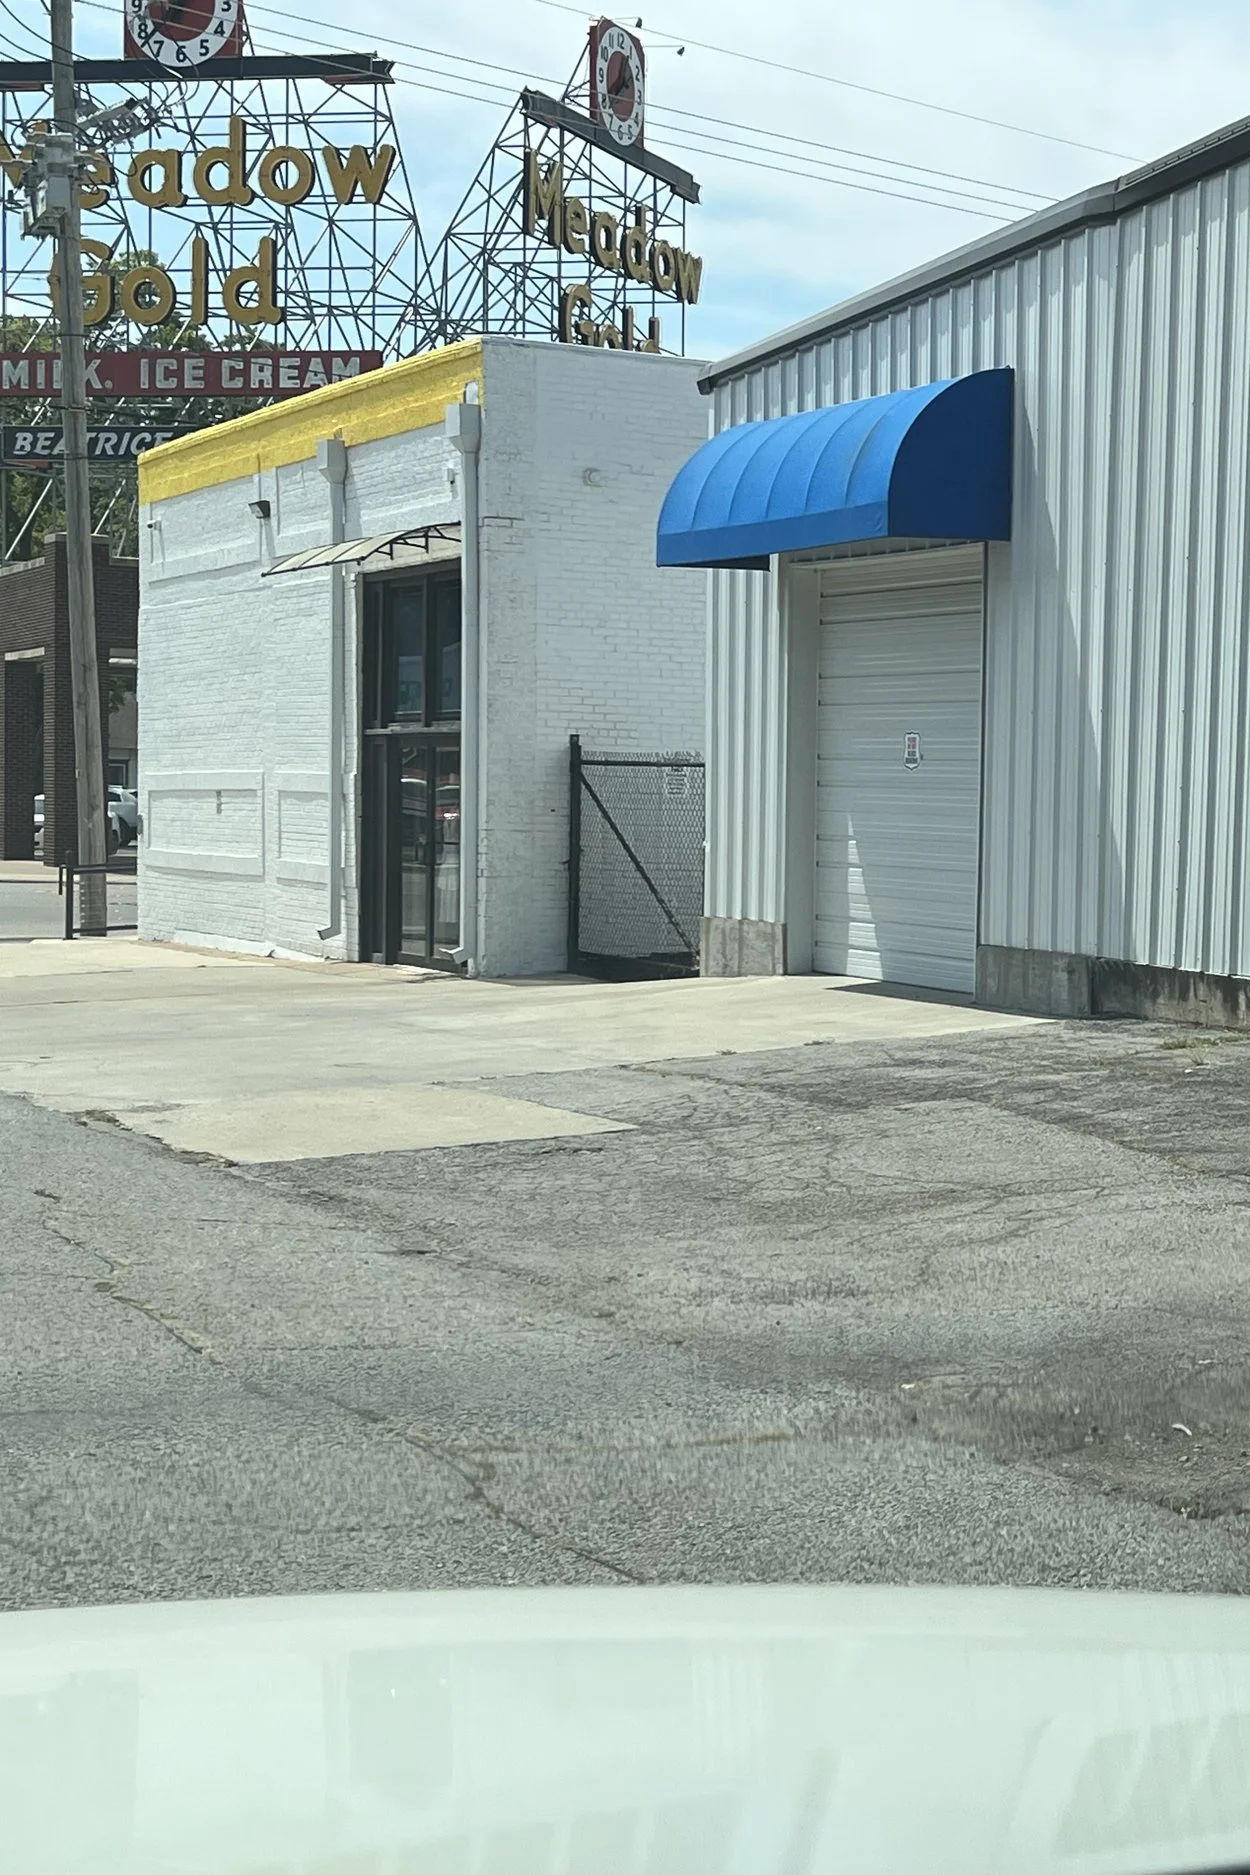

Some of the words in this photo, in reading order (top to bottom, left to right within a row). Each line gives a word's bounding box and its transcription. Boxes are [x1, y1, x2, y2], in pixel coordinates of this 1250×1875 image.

[132, 0, 142, 13] 9
[221, 0, 232, 12] 3
[138, 22, 148, 39] 8
[213, 20, 225, 36] 4
[153, 40, 164, 58] 7
[199, 39, 210, 56] 5
[609, 32, 614, 49] 11
[617, 32, 625, 50] 12
[176, 45, 187, 62] 6
[601, 45, 608, 62] 10
[599, 67, 604, 83] 9
[635, 65, 640, 81] 2
[602, 94, 607, 109] 8
[608, 113, 613, 130] 7
[618, 124, 623, 141] 6
[627, 124, 633, 140] 5
[0, 115, 396, 208] eadow
[524, 150, 702, 304] Meadow
[49, 236, 284, 326] Gold
[139, 358, 205, 389] ICE
[221, 357, 360, 389] CREAM
